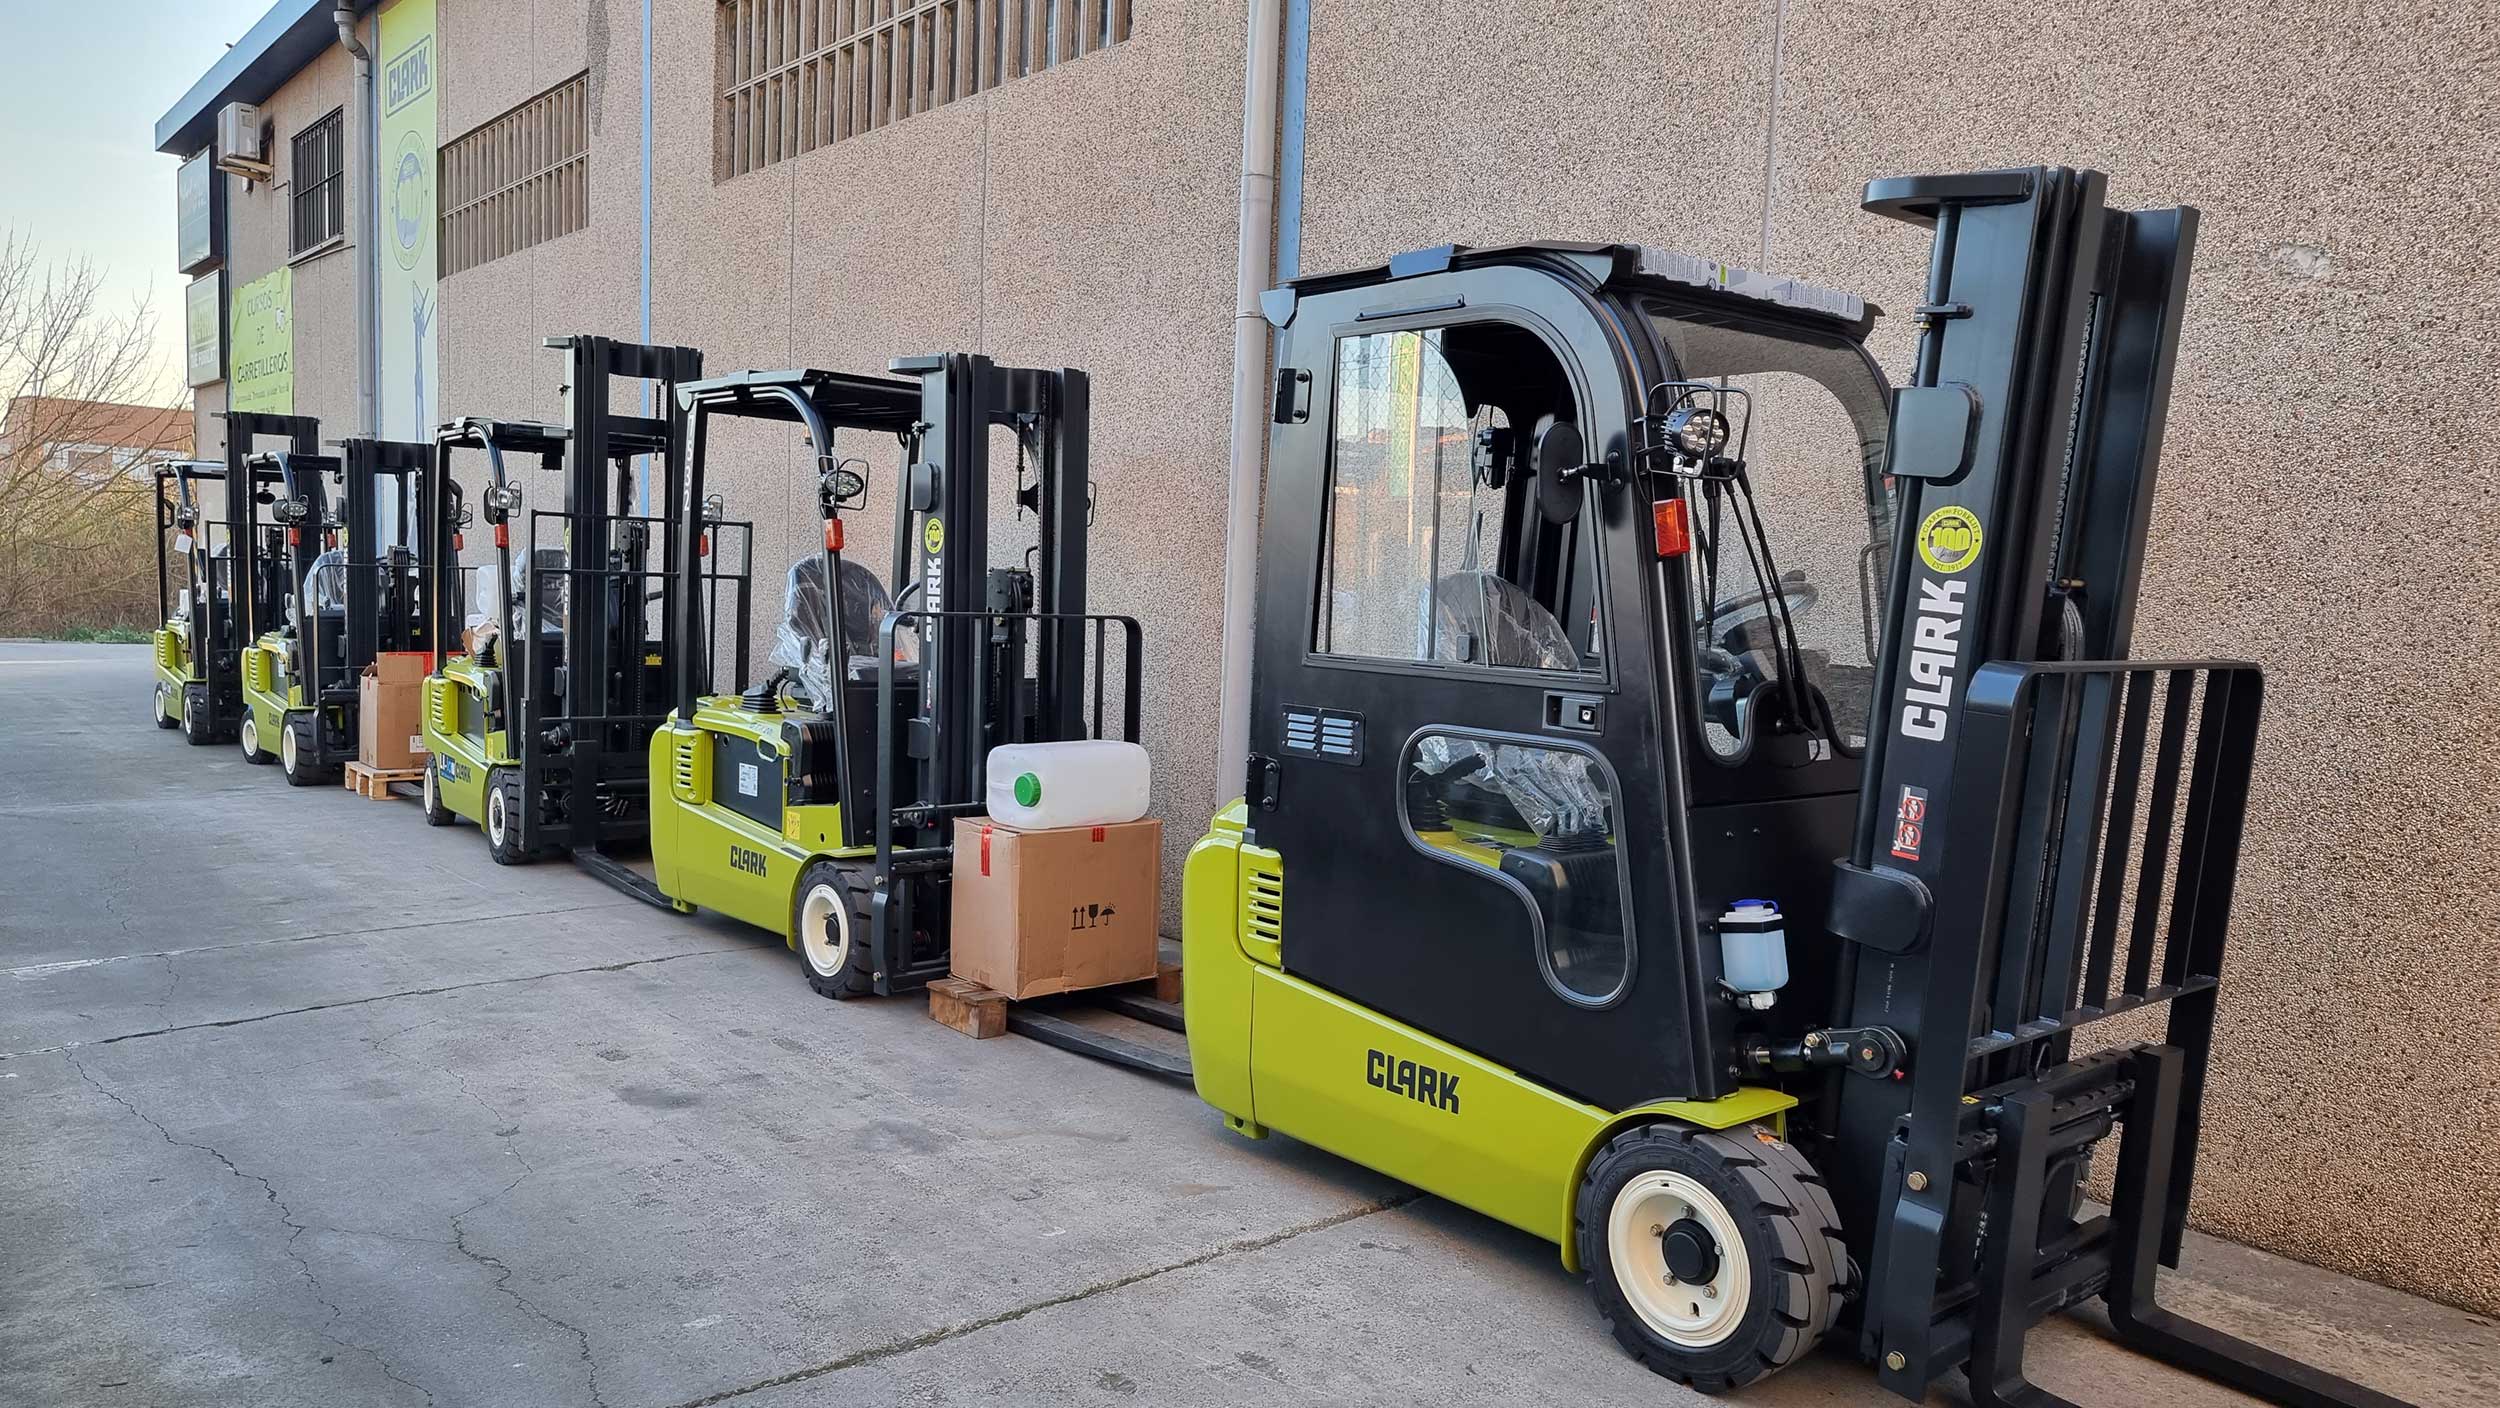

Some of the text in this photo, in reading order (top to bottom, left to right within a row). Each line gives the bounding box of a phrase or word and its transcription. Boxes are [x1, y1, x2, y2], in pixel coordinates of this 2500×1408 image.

[389, 46, 428, 107] CLARK
[247, 289, 272, 317] CURSOS
[237, 352, 288, 383] CARRETILLEROS
[1931, 527, 1970, 551] 100
[926, 558, 942, 642] ARK
[1901, 578, 1967, 742] CLARK
[730, 845, 766, 877] CLARK
[1367, 1048, 1460, 1115] CLARK
